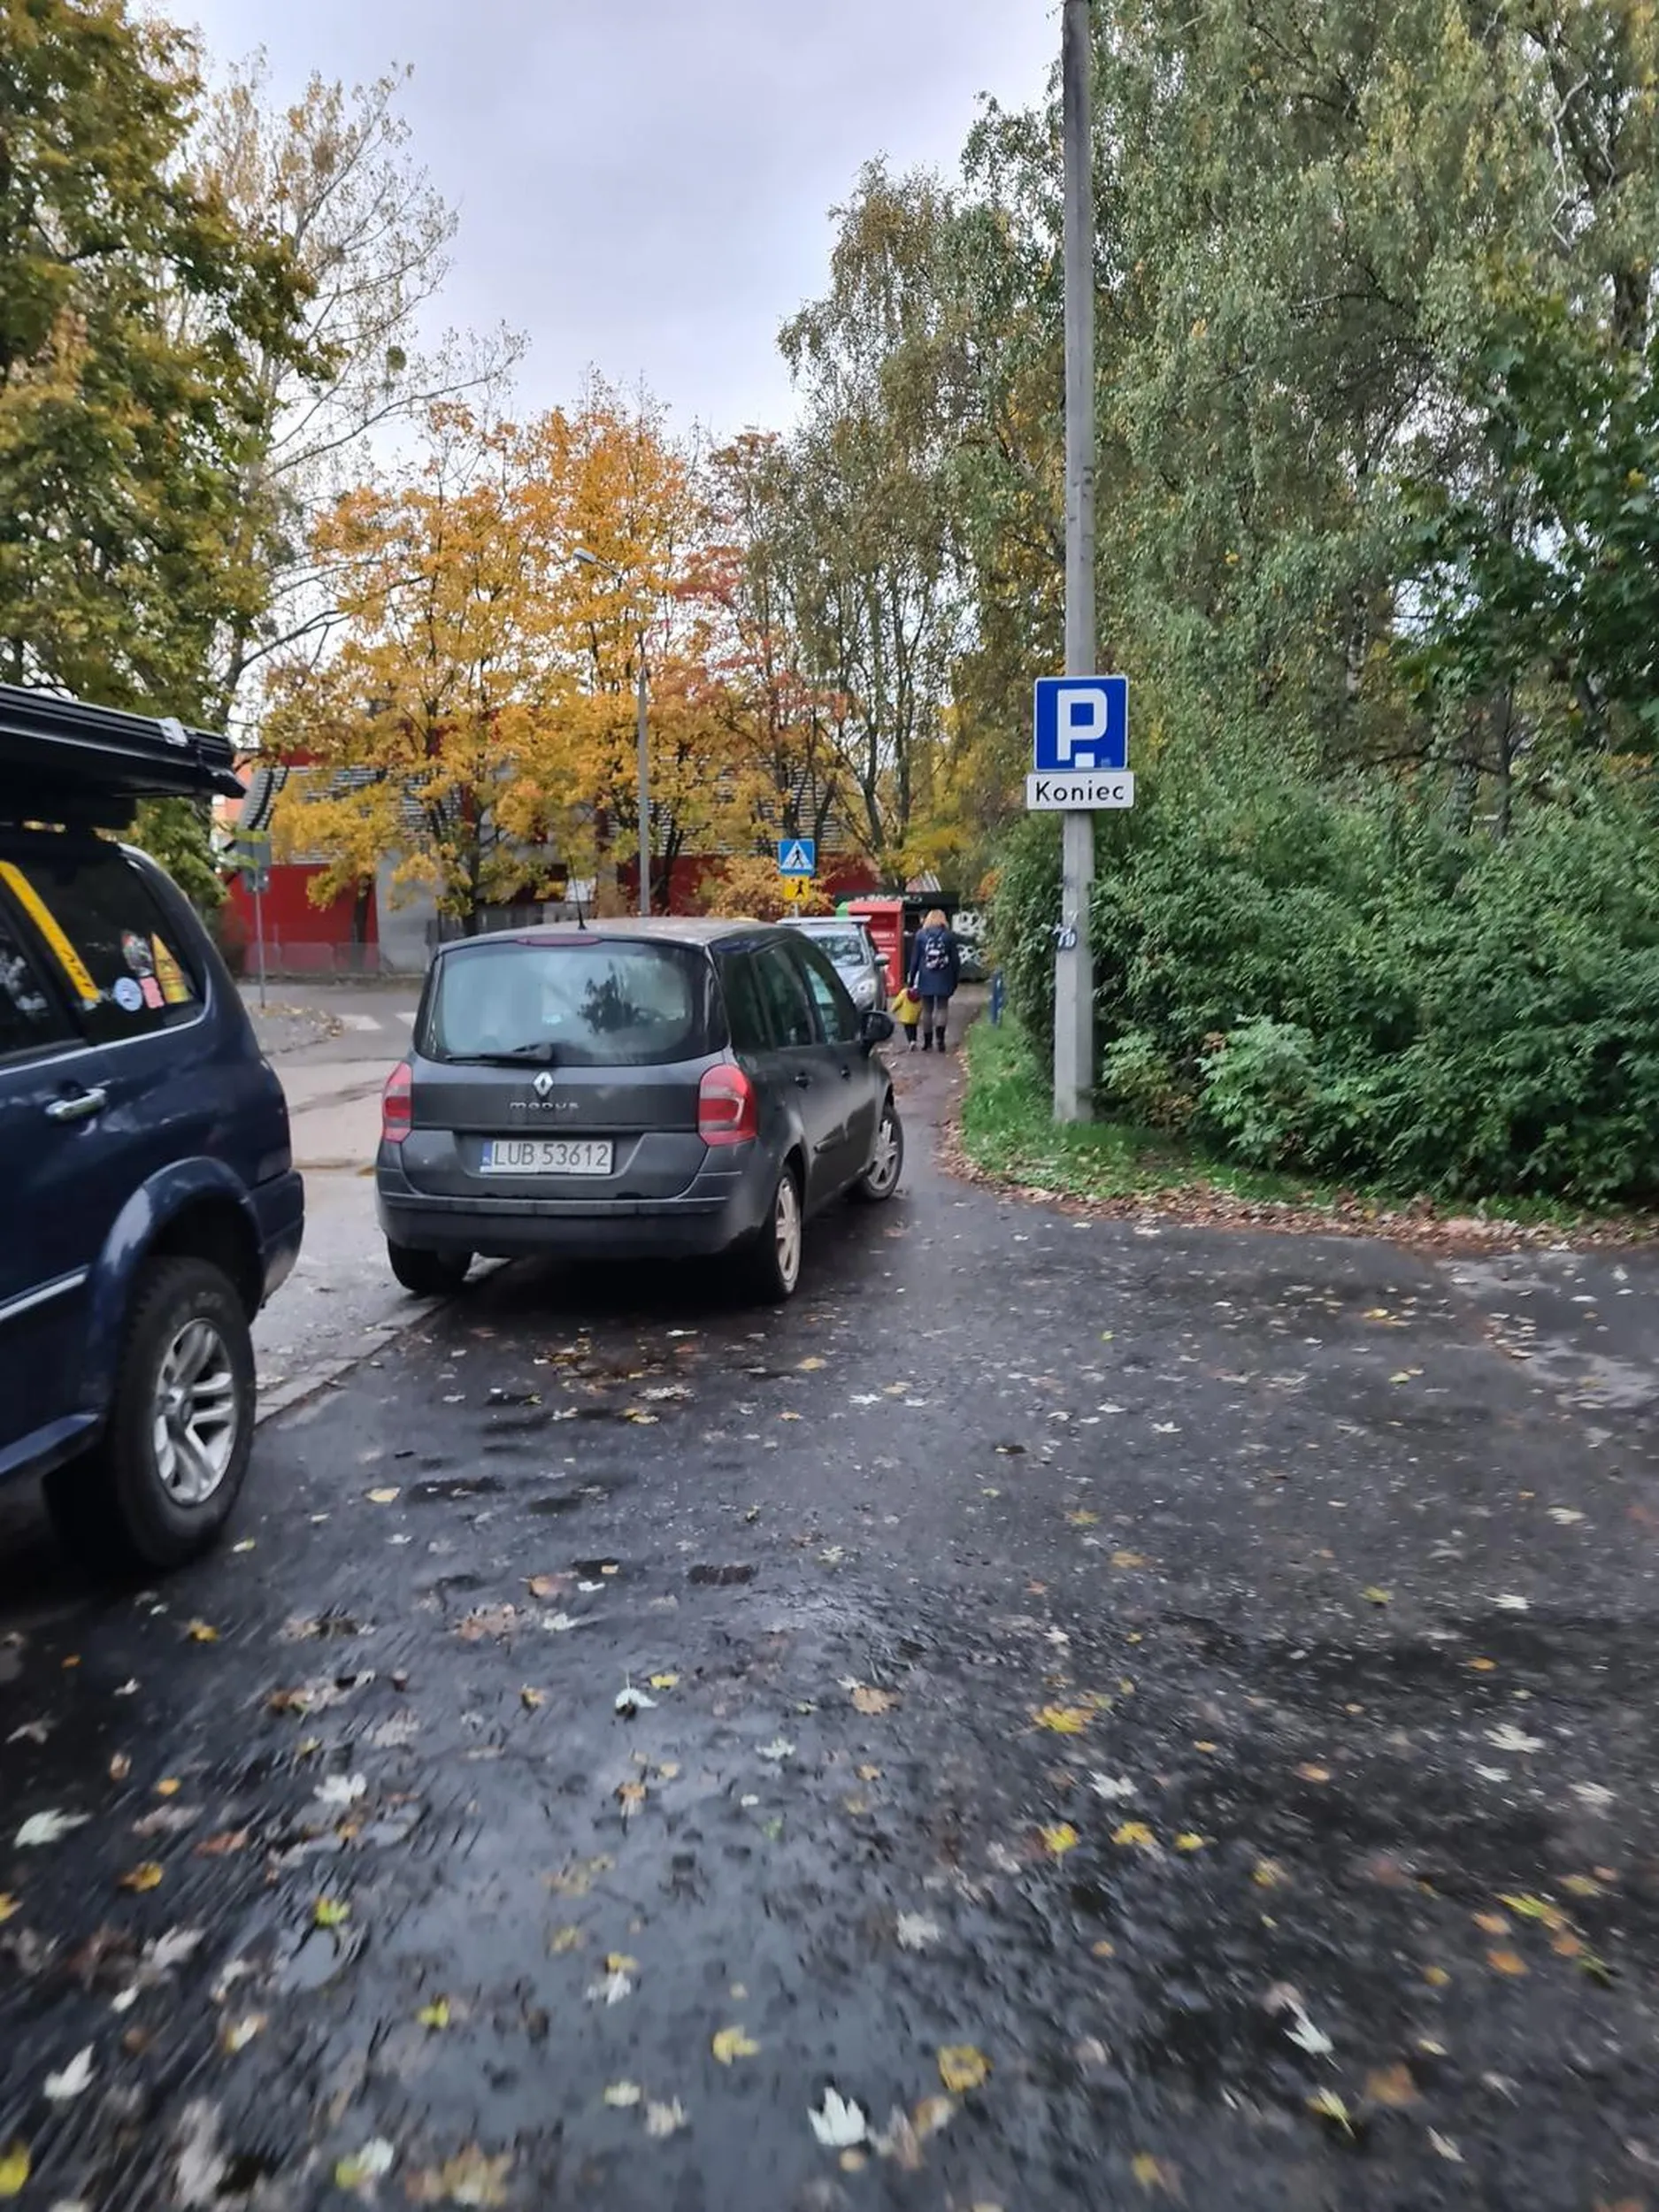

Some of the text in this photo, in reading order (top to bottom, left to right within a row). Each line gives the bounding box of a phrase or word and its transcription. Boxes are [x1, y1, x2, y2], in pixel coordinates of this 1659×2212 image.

[1056, 687, 1108, 761] P
[1035, 780, 1125, 802] Koniec
[494, 1142, 609, 1167] LUB 53612
